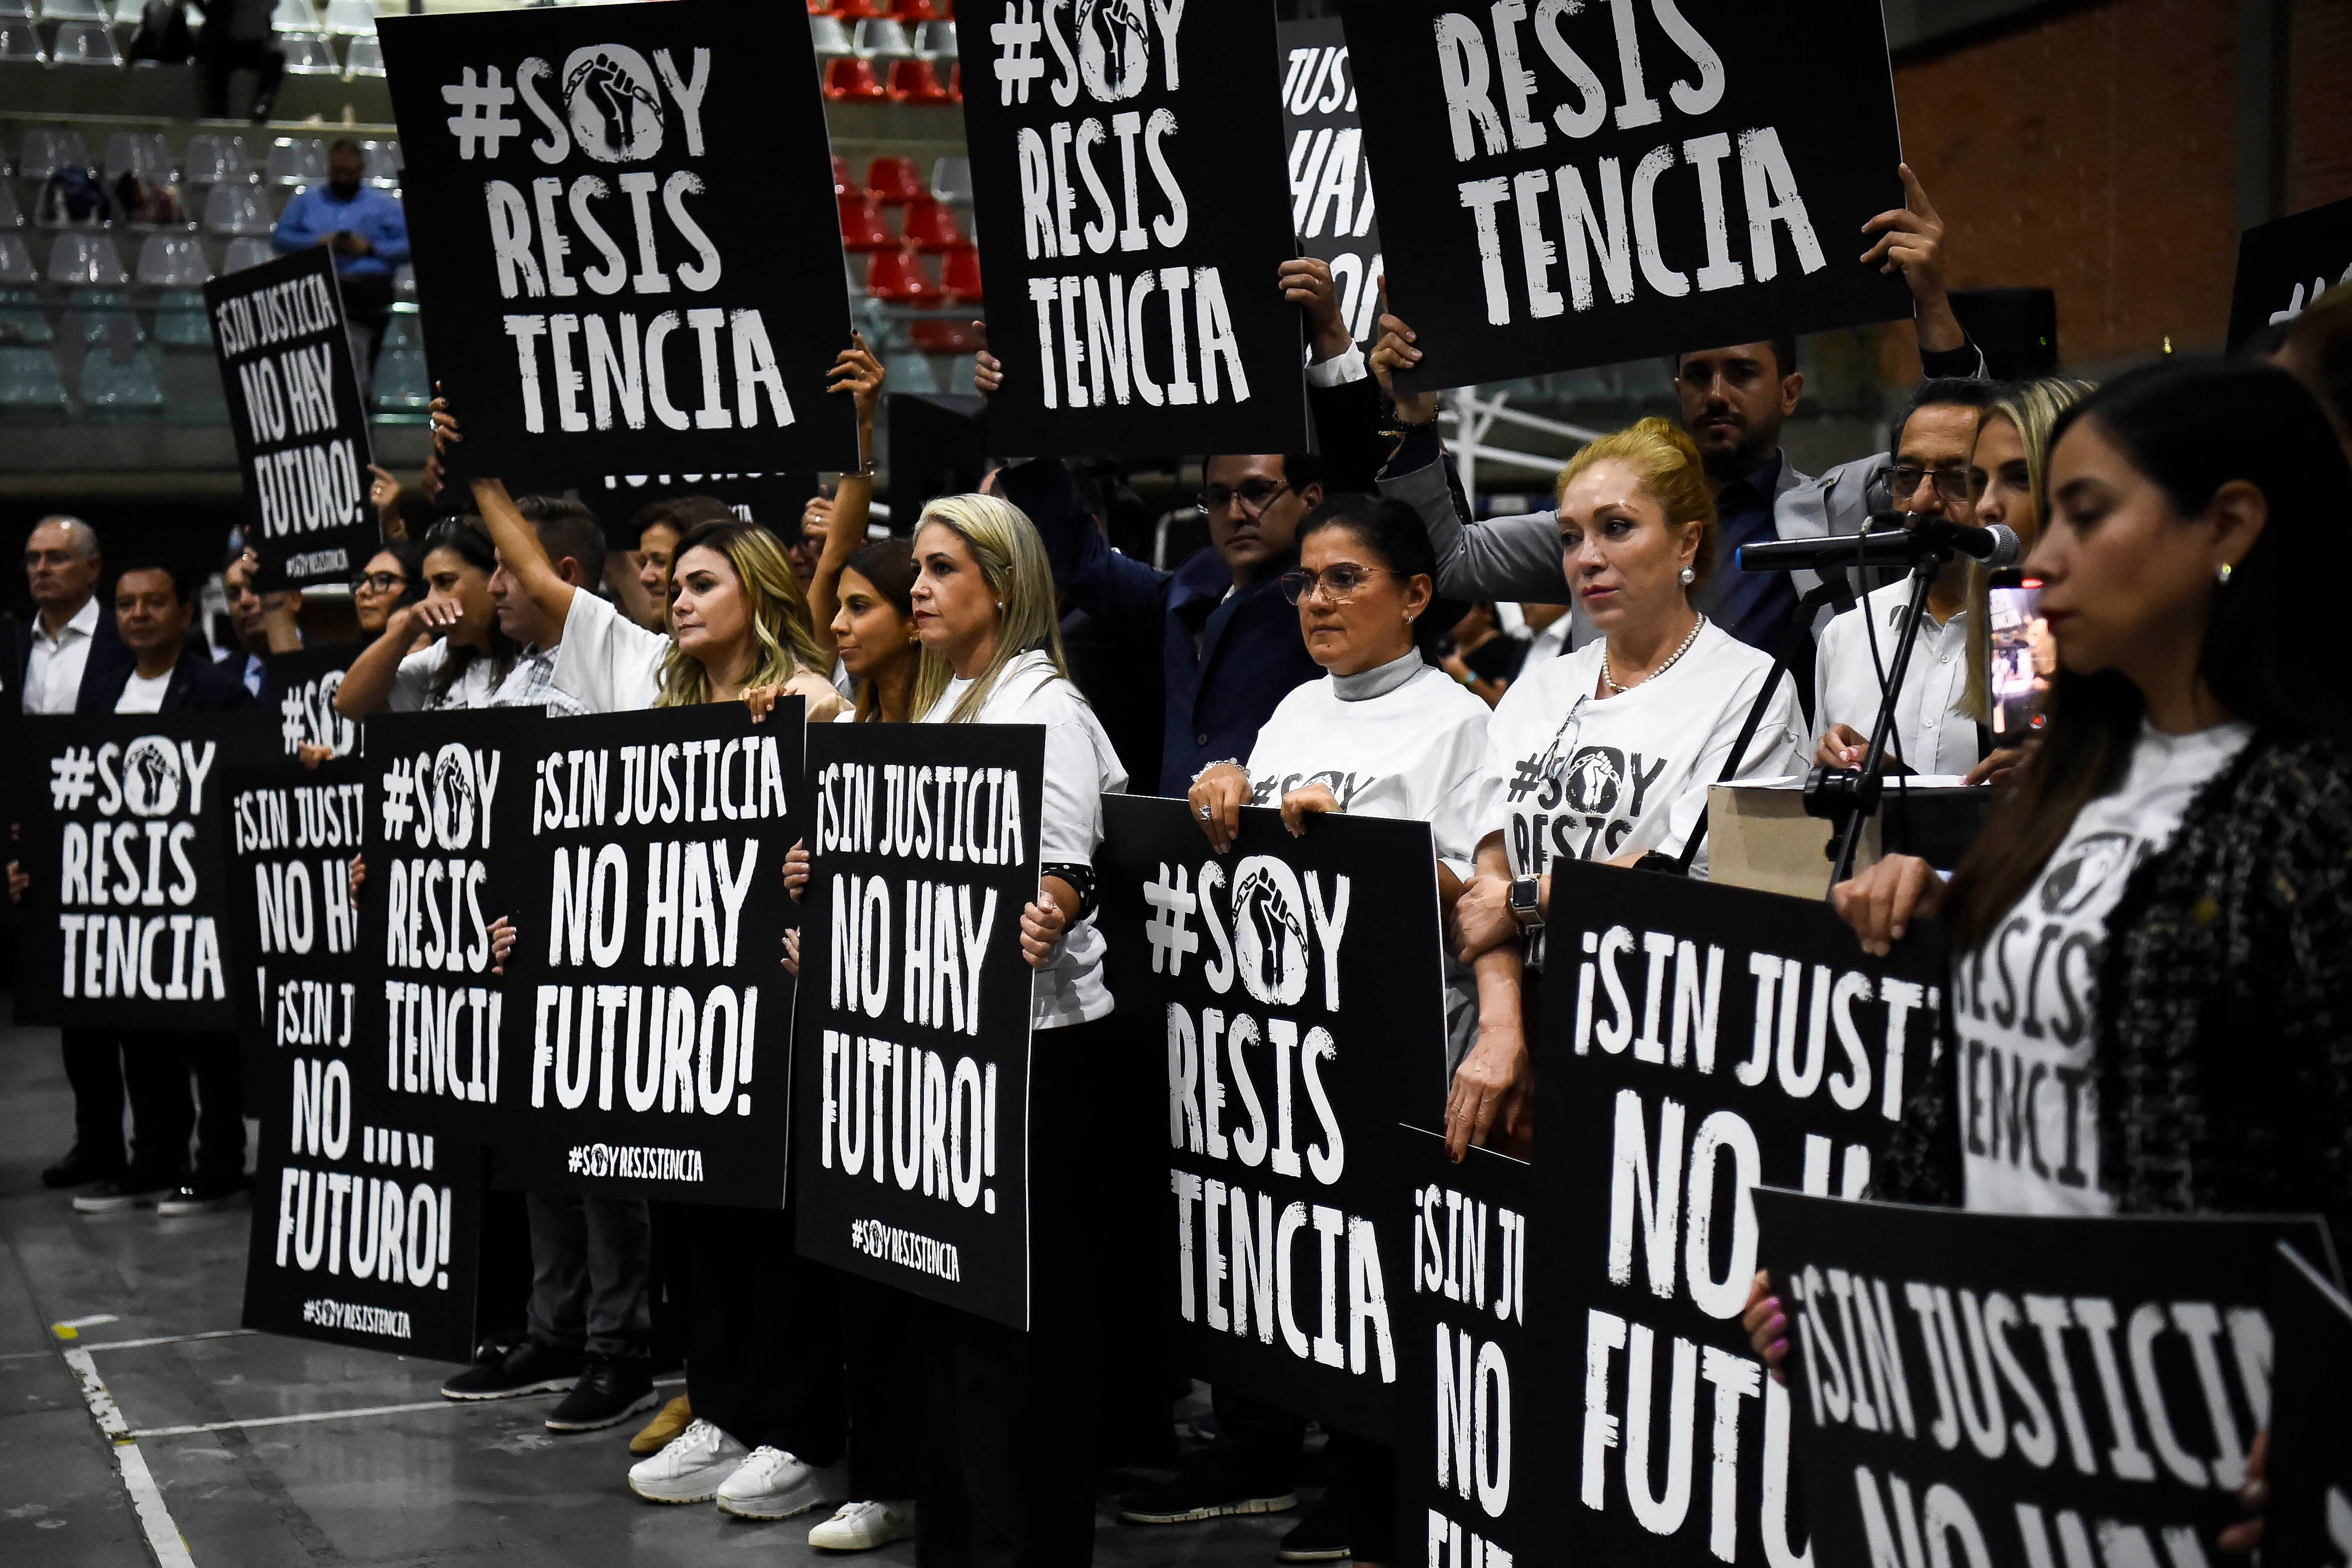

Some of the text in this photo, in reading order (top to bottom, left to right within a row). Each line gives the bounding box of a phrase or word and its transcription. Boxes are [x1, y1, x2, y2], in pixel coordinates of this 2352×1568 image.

[441, 44, 710, 164] #SOY
[1433, 0, 1725, 161] RESIS
[485, 171, 721, 298] RESIS
[1018, 108, 1188, 259] RESIS
[1458, 126, 1826, 326] TENCIA
[252, 272, 337, 346] JUSTICIA
[504, 308, 795, 433] TENCIA
[1029, 266, 1250, 409] TENCIA
[239, 341, 337, 445] NO HAY
[254, 438, 363, 540] FUTURO!
[51, 736, 215, 817] #SOY
[234, 790, 288, 854] ¡SIN
[383, 743, 500, 850] #SOY
[533, 736, 786, 835] ¡SIN JUSTICIA
[816, 763, 1024, 866] ¡SIN JUSTICIA
[62, 821, 196, 905] RESIS
[256, 861, 313, 953] NO
[387, 858, 489, 973] RESIS
[549, 838, 758, 967] NO HAY
[60, 914, 225, 1000] TENCIA
[831, 873, 997, 1035] NO HAY
[1143, 854, 1351, 1012] #SOY
[277, 980, 332, 1046] ¡SIN
[532, 985, 757, 1116] FUTURO!
[1574, 925, 1725, 1075] ¡SIN
[292, 1058, 350, 1160] NO
[822, 1030, 996, 1214] FUTURO!
[1167, 1001, 1344, 1186] RESIS
[276, 1168, 451, 1290] FUTURO!
[1415, 1184, 1486, 1310] ¡SIN
[1607, 1088, 1762, 1320] NO
[1170, 1169, 1397, 1385] TENCIA
[1790, 1264, 1917, 1440] ¡SIN
[1436, 1321, 1512, 1518] NO
